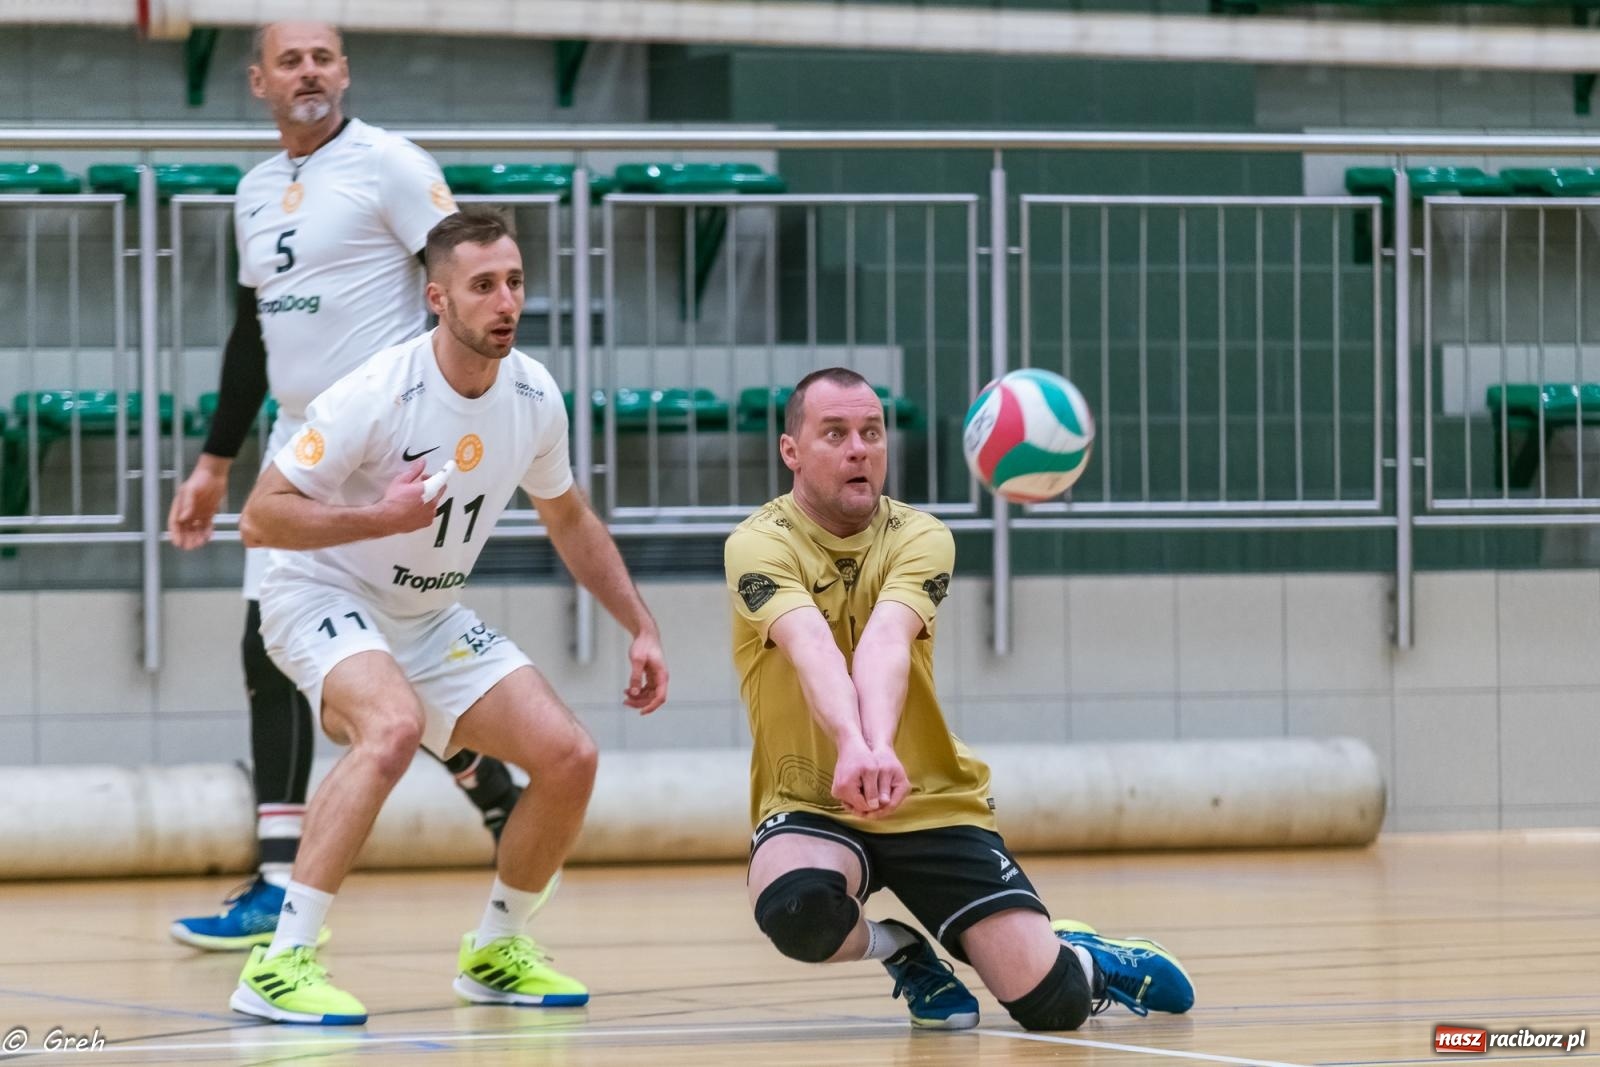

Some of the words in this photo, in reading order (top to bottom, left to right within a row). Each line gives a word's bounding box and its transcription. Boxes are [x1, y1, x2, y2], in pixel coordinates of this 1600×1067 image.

[276, 229, 297, 273] 5
[433, 494, 485, 548] 11
[392, 564, 467, 593] TropiDo
[317, 611, 368, 639] 11
